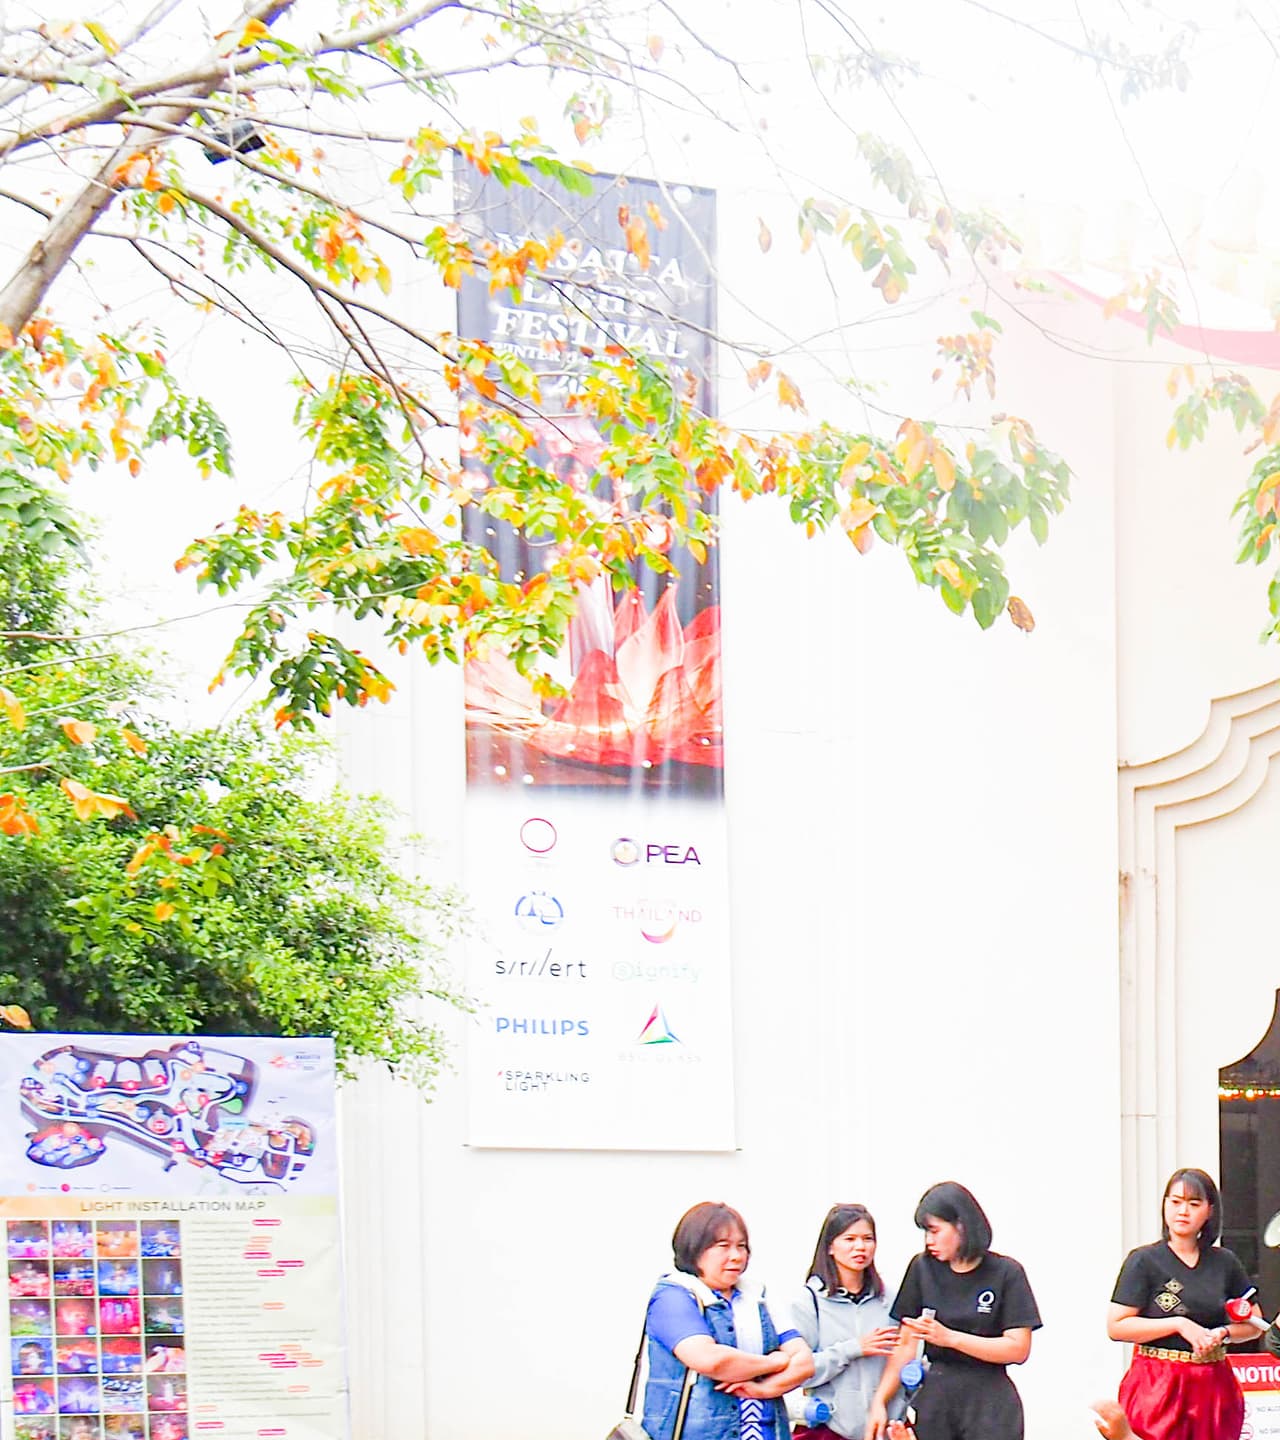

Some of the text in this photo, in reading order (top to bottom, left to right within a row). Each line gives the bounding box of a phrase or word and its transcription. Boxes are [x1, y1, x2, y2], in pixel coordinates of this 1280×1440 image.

[491, 305, 689, 359] FESTIVAL
[647, 843, 701, 866] PEA
[613, 905, 703, 923] THAILAND
[496, 1016, 589, 1036] PHILIPS
[505, 1069, 590, 1083] SPARKLING
[505, 1081, 549, 1093] LIGHT
[80, 1201, 266, 1212] LIGHT INSTALLATION MAP
